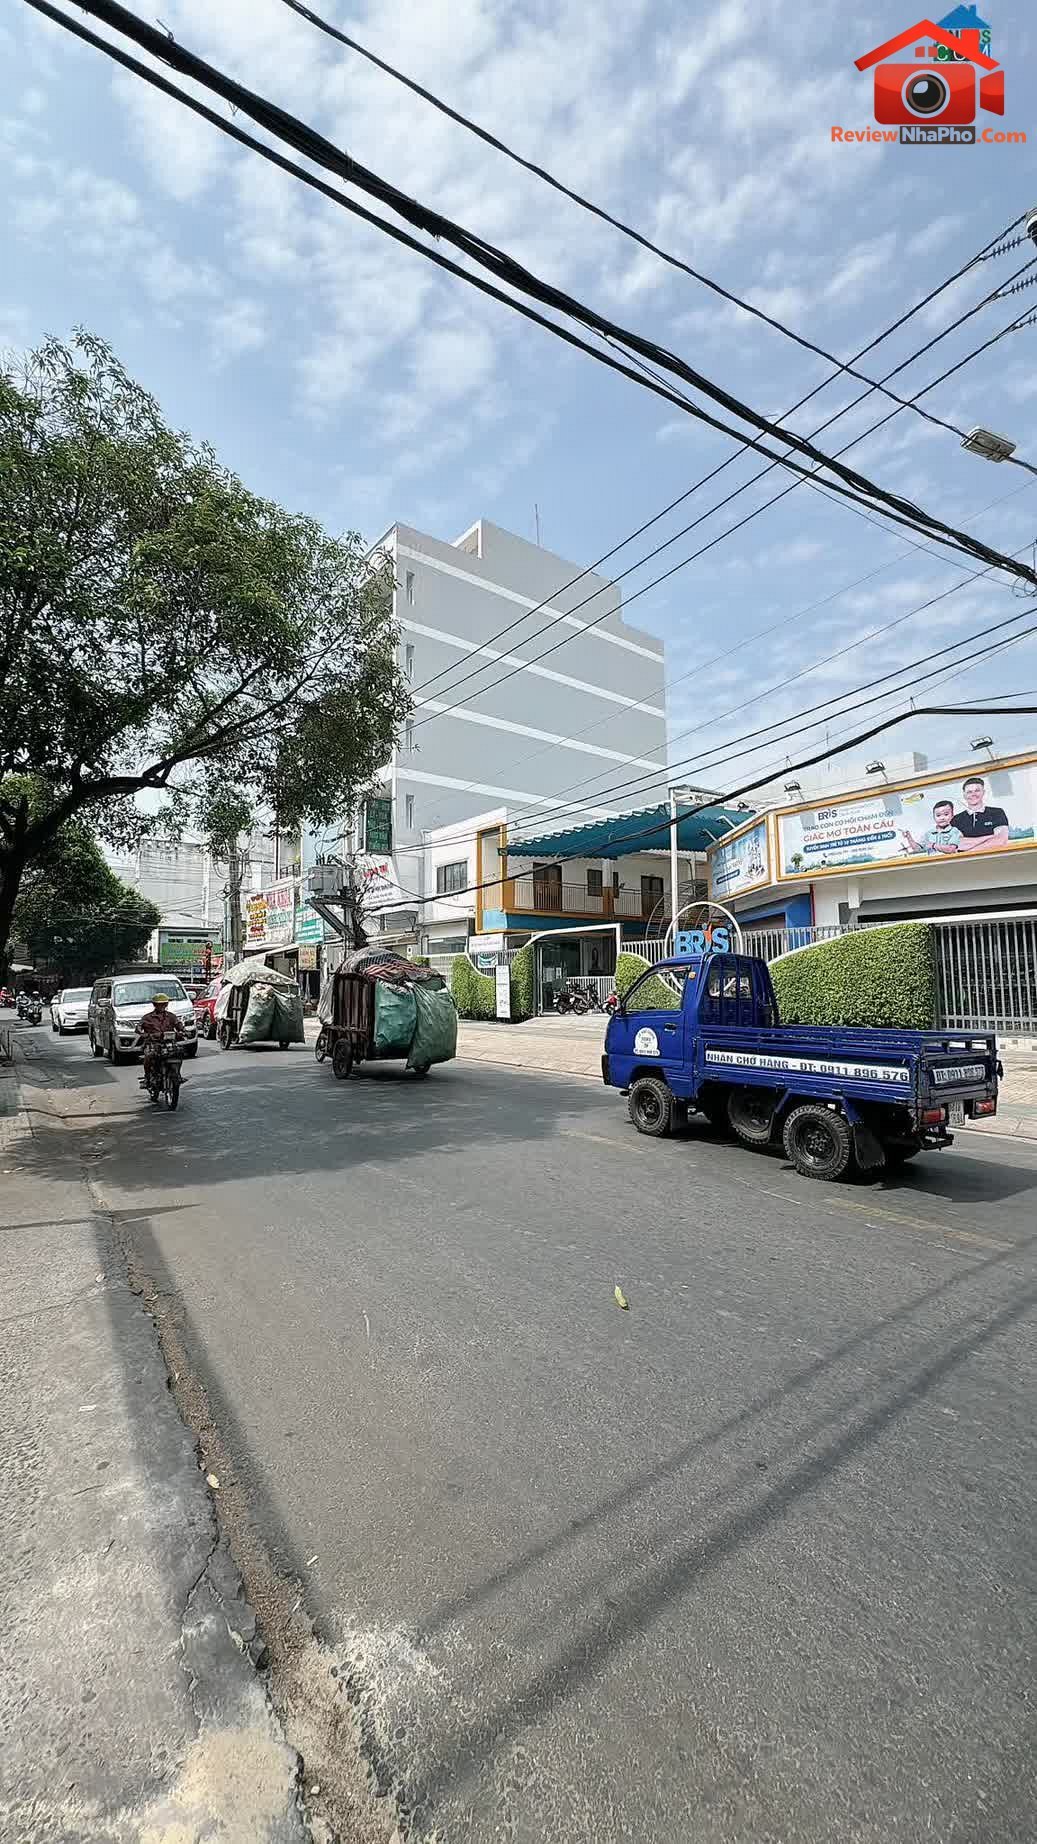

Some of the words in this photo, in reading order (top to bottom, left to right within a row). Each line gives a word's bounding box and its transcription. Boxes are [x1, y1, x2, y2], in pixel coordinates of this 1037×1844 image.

[820, 1064, 848, 1075] 0911
[854, 1067, 878, 1079] 896
[882, 1070, 908, 1082] 576
